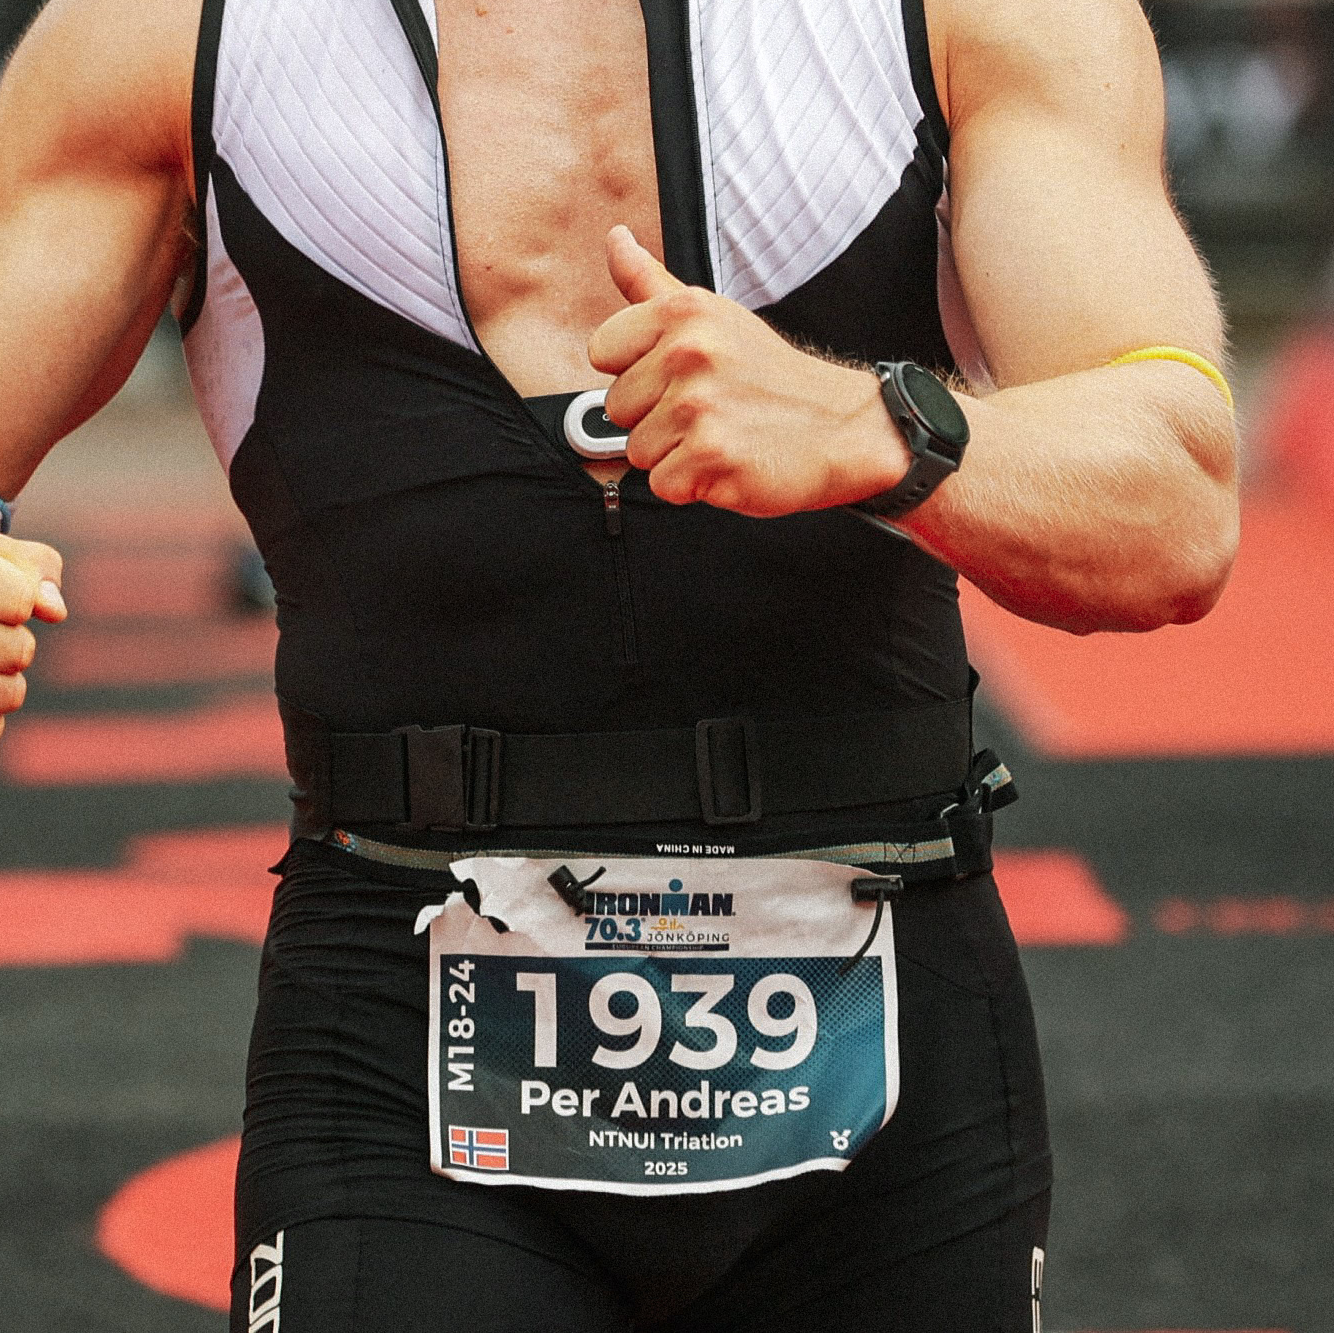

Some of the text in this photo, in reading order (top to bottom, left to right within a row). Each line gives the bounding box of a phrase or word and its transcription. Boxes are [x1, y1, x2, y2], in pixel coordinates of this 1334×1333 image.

[656, 843, 735, 855] MADE IN CHINA
[585, 918, 642, 942] 70.3
[447, 959, 476, 1092] M18-24
[516, 972, 817, 1070] 1939
[520, 1080, 811, 1119] Per Andreas
[589, 1130, 743, 1150] NTNUI Triatlon
[644, 1161, 688, 1175] 2025
